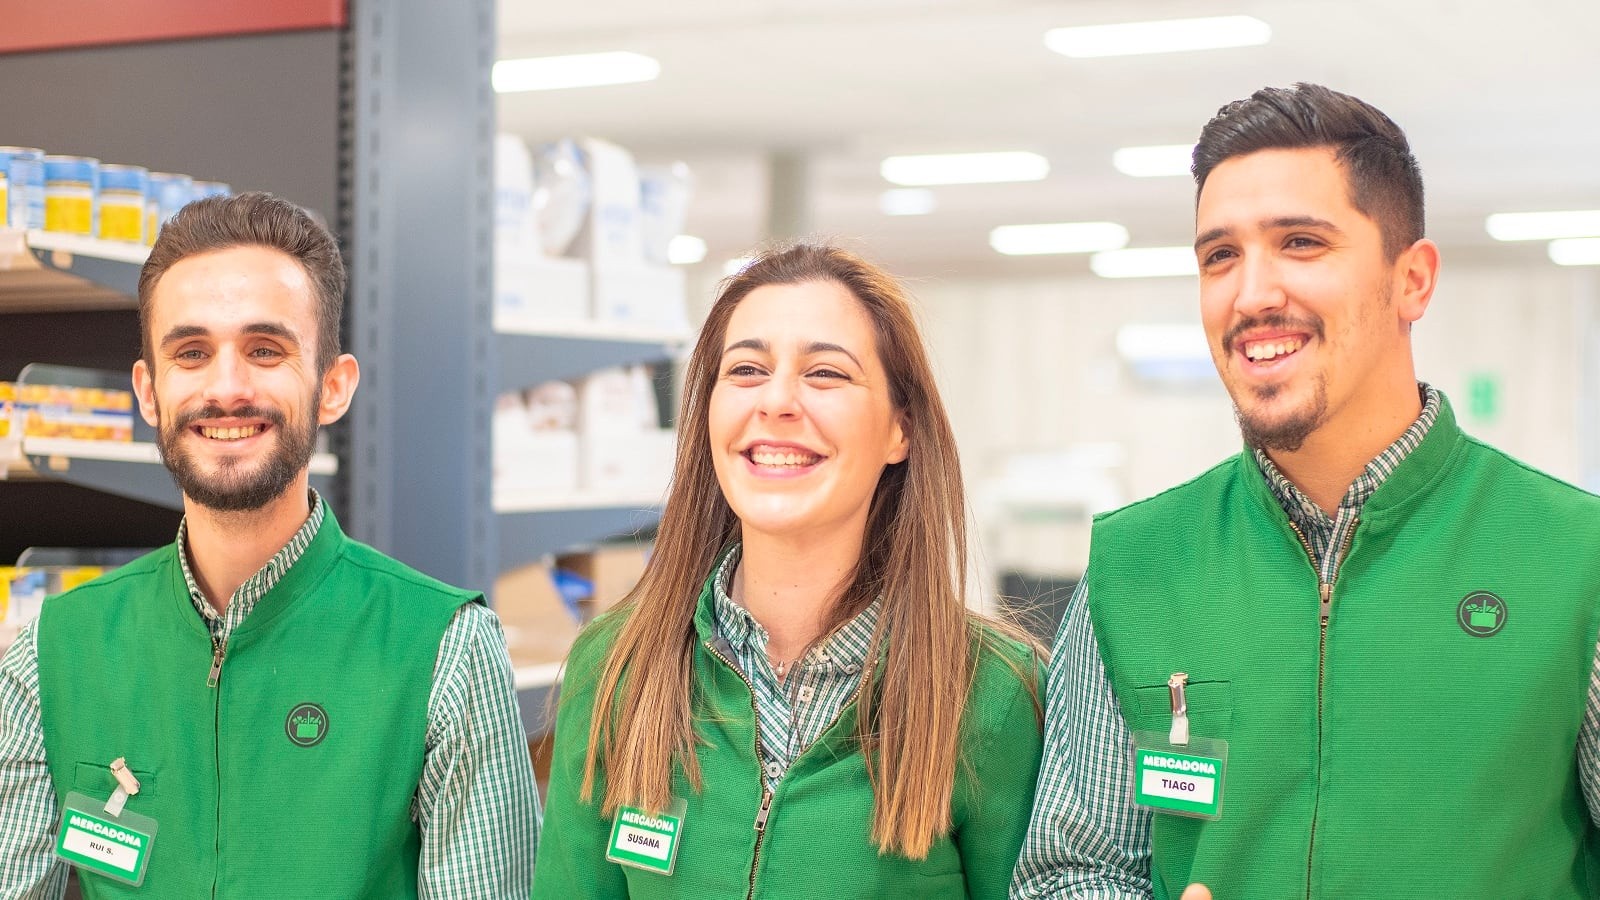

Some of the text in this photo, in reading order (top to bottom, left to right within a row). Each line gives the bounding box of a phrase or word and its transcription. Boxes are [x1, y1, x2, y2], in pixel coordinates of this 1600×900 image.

[1143, 755, 1216, 774] MERCADONA
[1162, 779, 1195, 792] TIAGO
[622, 811, 674, 832] MERCADONA
[70, 815, 141, 847] MERCADONA
[90, 841, 113, 855] RUI S.
[627, 833, 660, 848] SUSANA
